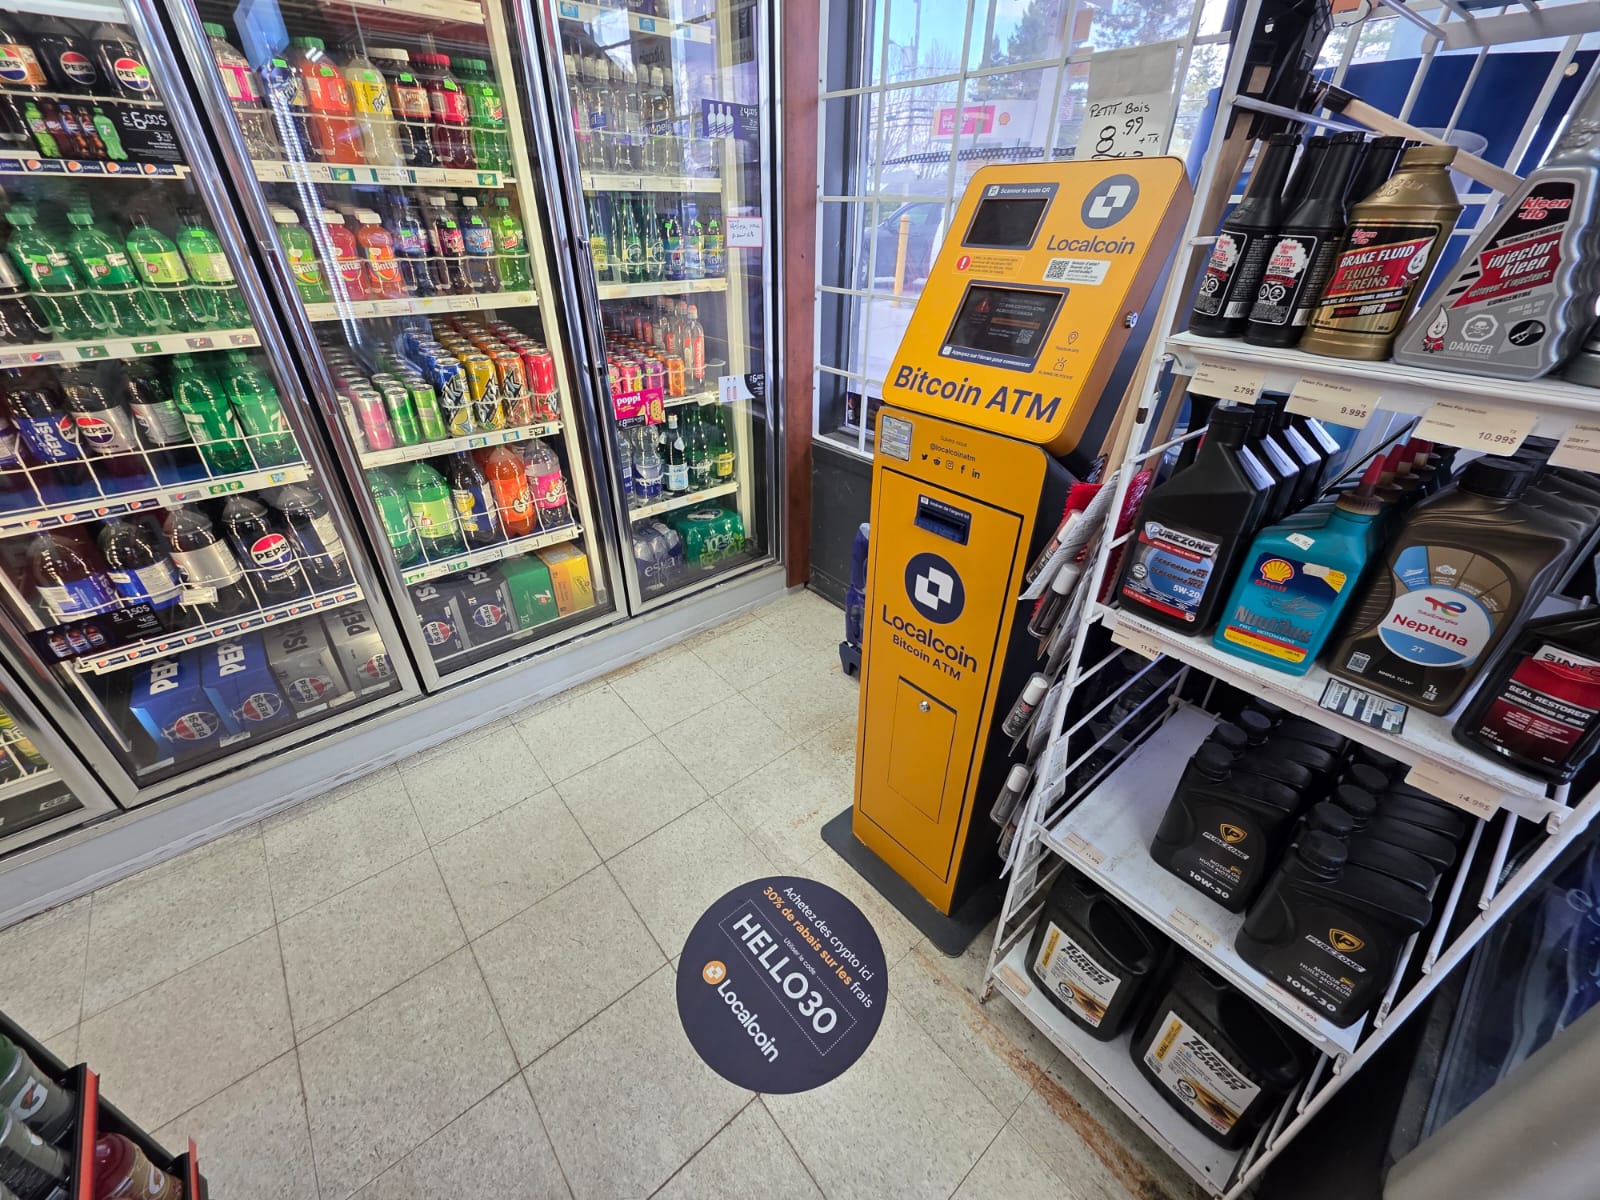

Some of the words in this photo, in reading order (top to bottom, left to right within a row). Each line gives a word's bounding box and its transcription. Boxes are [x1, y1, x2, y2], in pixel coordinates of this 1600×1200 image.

[1521, 197, 1571, 209] kleen
[1047, 235, 1136, 255] Localcoin
[1340, 252, 1378, 268] BRAKE
[1377, 245, 1415, 262] FLUID
[1486, 239, 1560, 270] injector
[1342, 265, 1385, 280] FLUIDE
[1499, 255, 1551, 279] kleen
[1345, 275, 1390, 290] FREINS
[1449, 341, 1494, 355] DANGER
[616, 392, 641, 407] poppi
[894, 365, 982, 406] Bitcoin
[985, 386, 1062, 424] ATM
[1340, 406, 1367, 418] 9.99$
[35, 421, 67, 457] PEPSI
[930, 443, 976, 462] @localcoinatm
[1478, 431, 1518, 445] 10.99$
[256, 543, 290, 561] PEPSI
[1149, 522, 1215, 554] PUREZONE
[644, 556, 676, 577] eska
[1172, 584, 1201, 599] 5W-20
[882, 604, 978, 672] Localcoin
[1392, 613, 1468, 647] Neptuna
[893, 634, 930, 663] Bitcoin
[932, 658, 961, 681] ATM
[1411, 645, 1425, 654] 2T
[1508, 684, 1534, 700] SEAL
[1534, 696, 1591, 720] RESTORER
[1189, 870, 1230, 899] 10W-30
[763, 886, 785, 909] 30%
[781, 907, 795, 922] de
[793, 920, 821, 952] rabais
[819, 948, 838, 970] sur
[835, 965, 853, 986] les
[849, 981, 873, 1009] frais
[784, 887, 816, 922] Achetez
[814, 920, 831, 939] des
[830, 936, 860, 968] crypto
[860, 964, 875, 981] ici
[732, 912, 838, 1034] HELLO30
[802, 958, 816, 976] code
[1060, 947, 1104, 986] POWER
[1066, 942, 1115, 984] TURBO
[1285, 974, 1336, 1012] 10W-30
[1300, 962, 1320, 977] HUILE
[1319, 976, 1351, 997] MOTEUR
[1313, 966, 1340, 985] MOTOR
[1340, 983, 1353, 994] OIL
[716, 978, 779, 1063] Localcoin
[1183, 1041, 1240, 1091] POWER
[1188, 1035, 1253, 1090] TURBO
